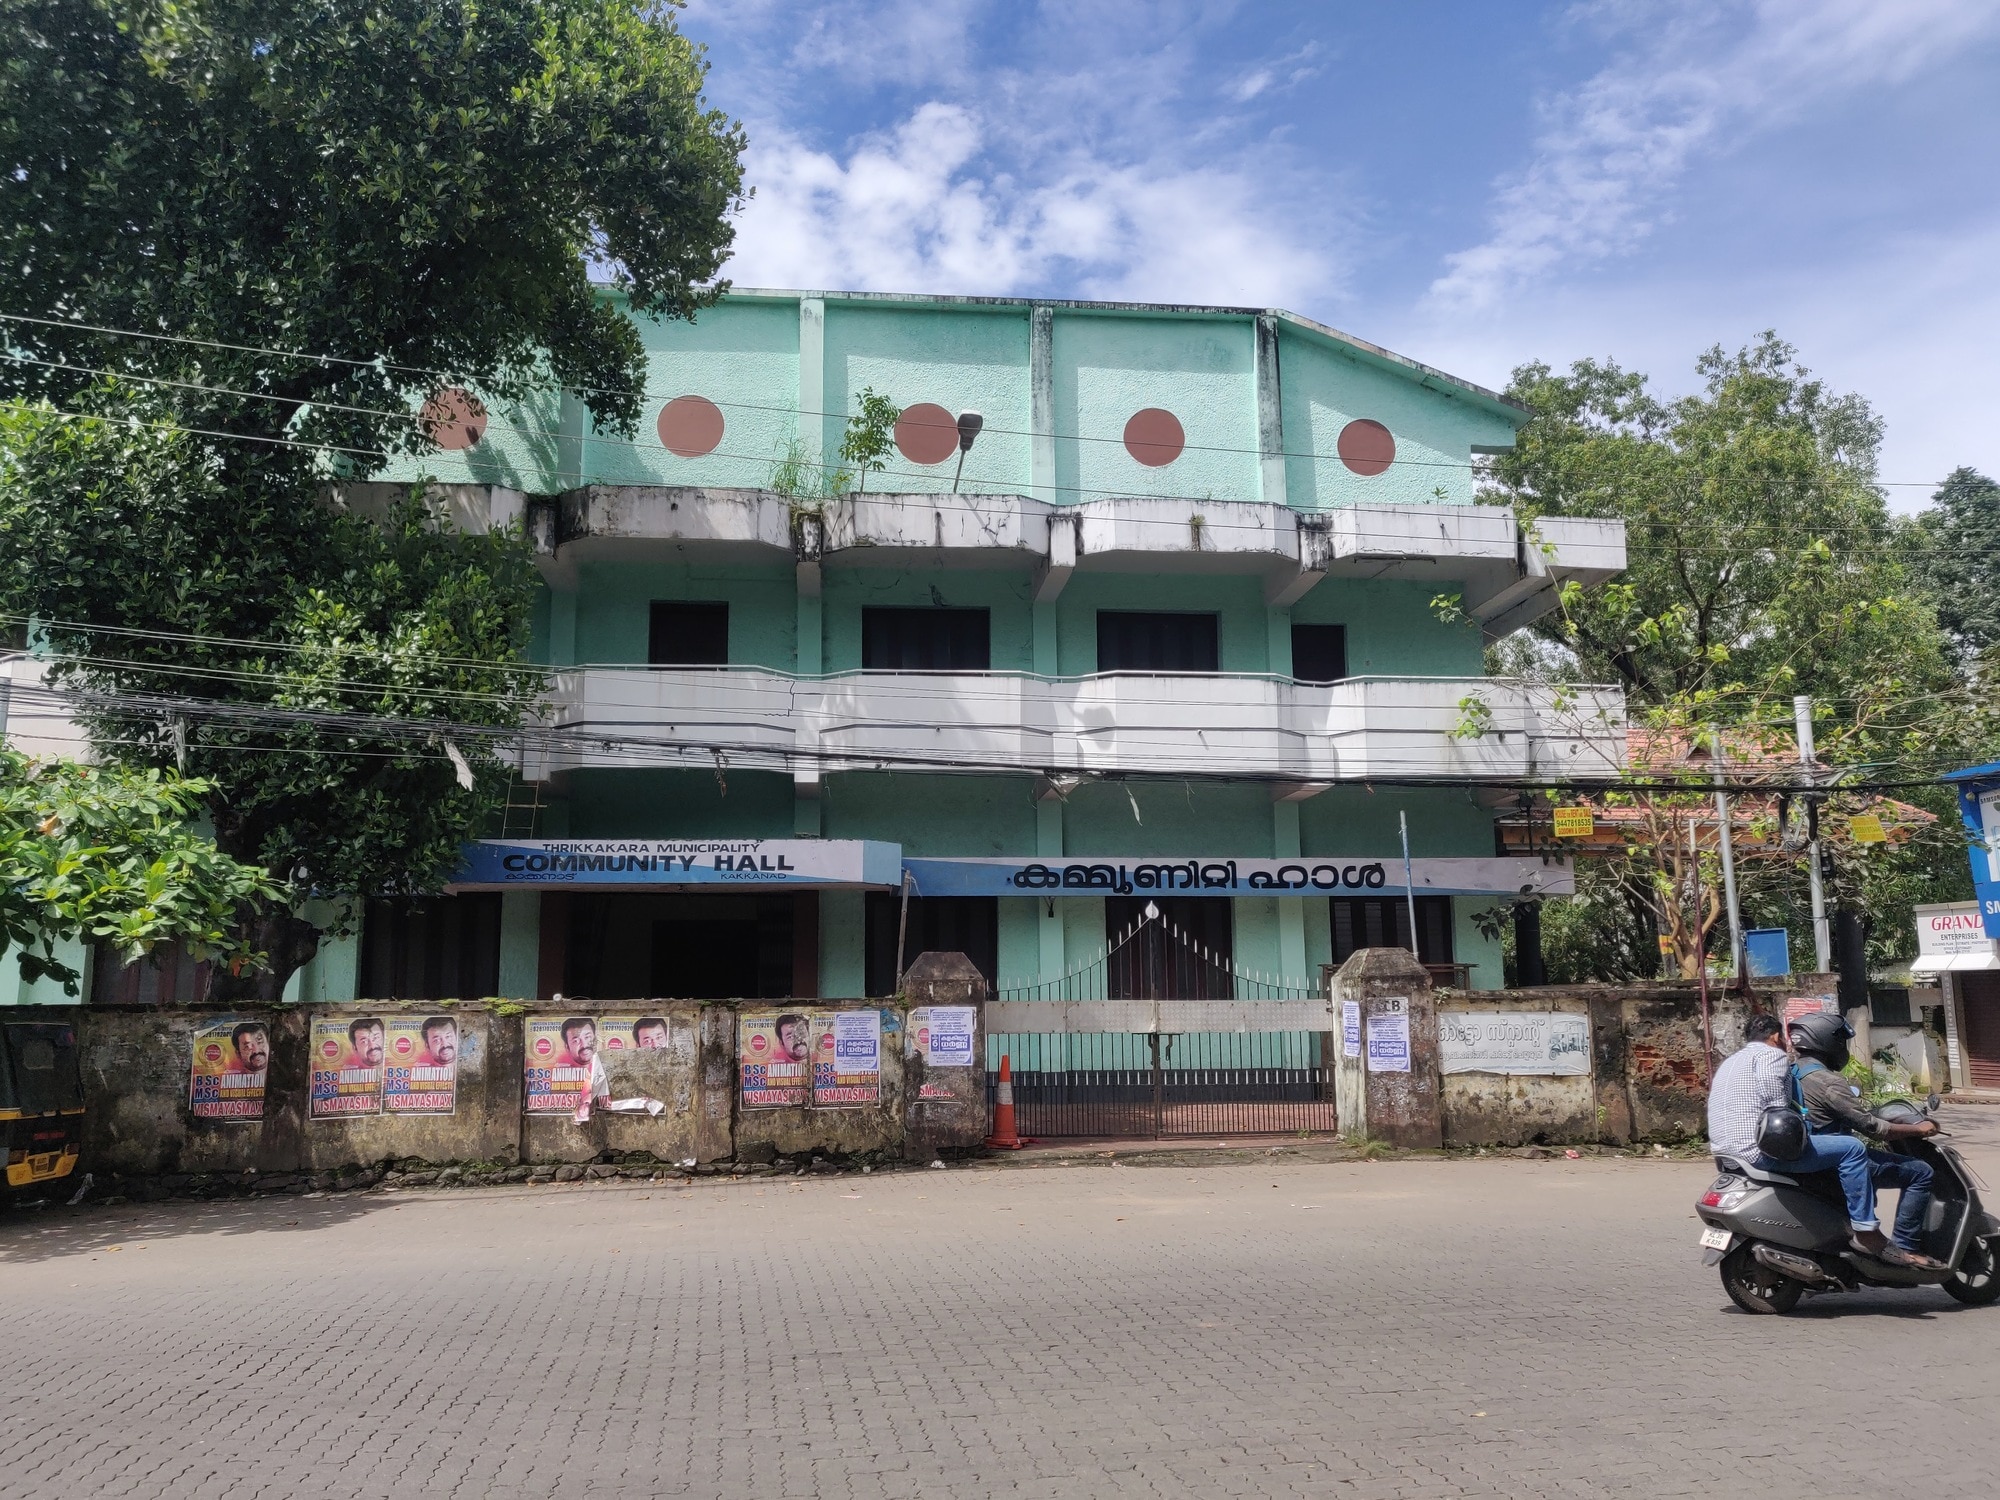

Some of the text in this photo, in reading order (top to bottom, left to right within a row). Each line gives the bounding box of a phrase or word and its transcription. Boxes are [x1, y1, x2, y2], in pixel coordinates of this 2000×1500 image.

[542, 843, 760, 853] THRIKKAKARA MUNICIPALITY
[502, 854, 795, 872] COMMUNITY HALL
[1931, 914, 1984, 931] GRAND
[1940, 932, 1979, 941] ENTERPRISES
[932, 1039, 938, 1047] 6
[837, 1045, 844, 1053] 6
[1371, 1045, 1377, 1053] 6
[411, 1066, 453, 1081] ANIMATION
[220, 1073, 265, 1089] ANIMATION
[386, 1080, 410, 1091] MSc
[529, 1080, 550, 1091] MSc
[744, 1076, 766, 1087] MSc
[194, 1087, 219, 1099] MSc
[314, 1082, 338, 1094] MSc
[386, 1093, 452, 1108] VISMAYASMAX
[193, 1101, 264, 1116] VISMAYASMAX
